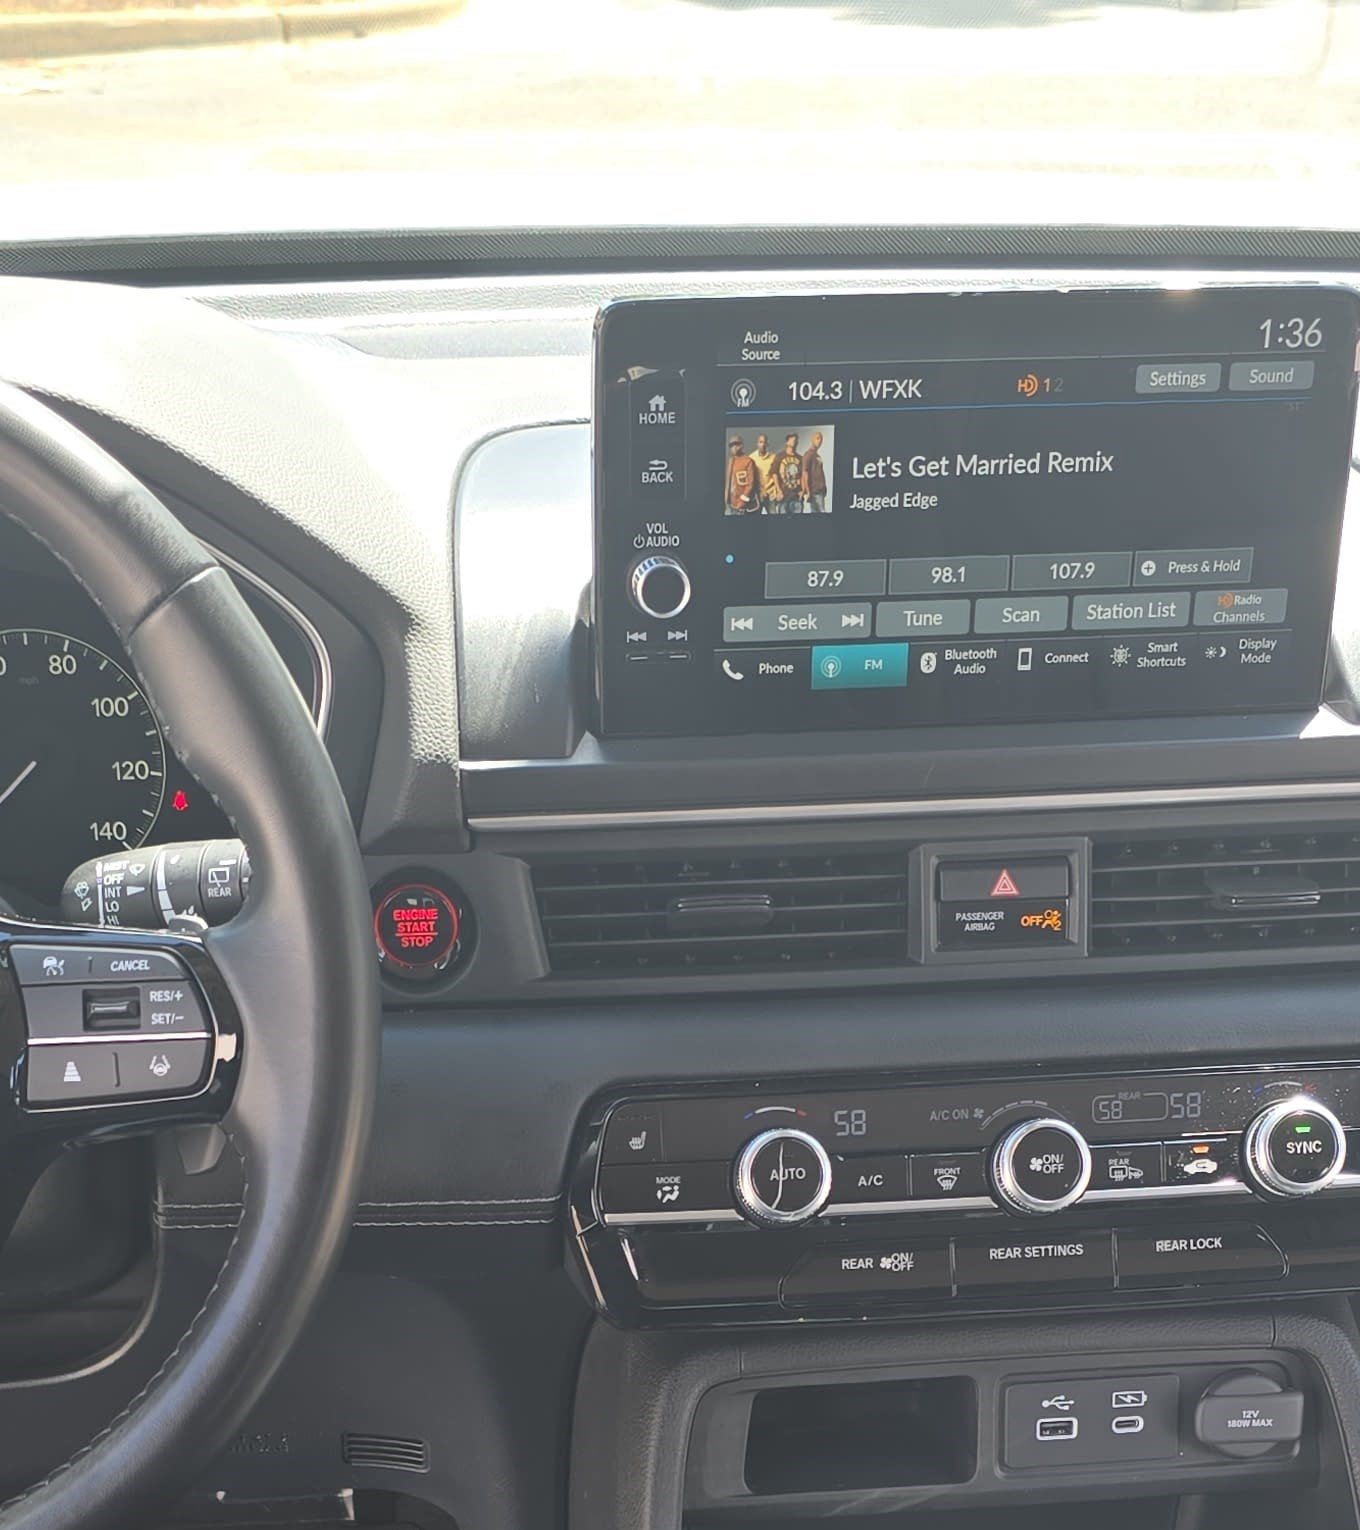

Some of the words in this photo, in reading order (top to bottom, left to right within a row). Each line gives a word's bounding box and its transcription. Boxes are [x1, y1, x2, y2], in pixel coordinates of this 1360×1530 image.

[744, 331, 779, 345] Audio
[1259, 317, 1323, 348] 1:36
[741, 348, 781, 361] Source
[1149, 371, 1206, 389] Settings
[1249, 368, 1294, 384] Sound
[789, 381, 843, 401] 104.3
[860, 379, 923, 400] WFXK
[638, 412, 676, 425] HOME
[852, 456, 902, 480] Let's
[909, 455, 949, 477] Get
[955, 452, 1040, 477] Married
[1047, 451, 1114, 473] Remix
[641, 471, 674, 484] BACK
[849, 493, 900, 510] Jagged
[904, 492, 938, 509] Edge
[646, 523, 669, 535] VOL
[646, 535, 680, 548] AUDIO
[1049, 562, 1096, 580] 107.9
[1168, 560, 1198, 575] Press
[1200, 560, 1210, 573] &
[1213, 558, 1241, 573] Hold
[807, 570, 844, 588] 87.9
[931, 566, 966, 584] 98.1
[1234, 594, 1262, 606] Radio
[903, 610, 943, 627] Tune
[1002, 607, 1041, 623] Scan
[1086, 604, 1143, 621] Station
[1147, 602, 1176, 619] List
[1213, 610, 1265, 624] Channels
[777, 613, 818, 631] Seek
[1147, 641, 1178, 654] Smart
[1239, 638, 1277, 652] Display
[944, 648, 997, 661] Bluetooth
[1044, 651, 1089, 665] Connect
[1240, 651, 1272, 664] Mode
[48, 654, 77, 675] 80
[758, 662, 794, 675] Phone
[864, 660, 883, 671] FM
[953, 662, 986, 675] Audio
[1137, 655, 1186, 669] Shortcuts
[90, 697, 129, 718] 100
[112, 762, 150, 782] 120
[89, 822, 127, 841] 140
[103, 873, 124, 886] OFF
[104, 886, 121, 898] INT
[208, 887, 232, 898] REAR
[105, 901, 120, 912] LO
[107, 915, 120, 926] HI
[393, 908, 439, 922] ENGINE
[955, 911, 1005, 922] PASSENGER
[1020, 915, 1043, 927] OFF
[397, 921, 435, 933] START
[964, 922, 996, 932] AIRBAG
[400, 935, 433, 948] STOP
[110, 958, 151, 973] CANCEL
[150, 988, 184, 1004] RES/+
[1098, 1100, 1123, 1120] 58
[1169, 1092, 1202, 1119] 58
[929, 1109, 950, 1122] A/C
[952, 1107, 970, 1121] ON
[834, 1110, 867, 1136] 58
[1286, 1140, 1323, 1154] SYNC
[1042, 1152, 1064, 1165] ON/
[1108, 1158, 1130, 1166] REAR
[770, 1167, 807, 1181] AUTO
[934, 1167, 961, 1176] FRONT
[1042, 1163, 1065, 1174] OFF
[656, 1176, 681, 1185] MODE
[857, 1174, 884, 1188] A/C
[989, 1246, 1022, 1259] REAR
[1024, 1244, 1084, 1258] SETTINGS
[1156, 1239, 1187, 1252] REAR
[1189, 1237, 1223, 1250] LOCK
[841, 1257, 874, 1270] REAR
[891, 1252, 914, 1263] ON/
[891, 1261, 914, 1272] OFF
[1242, 1409, 1260, 1419] 12V
[1252, 1418, 1273, 1428] MAX
